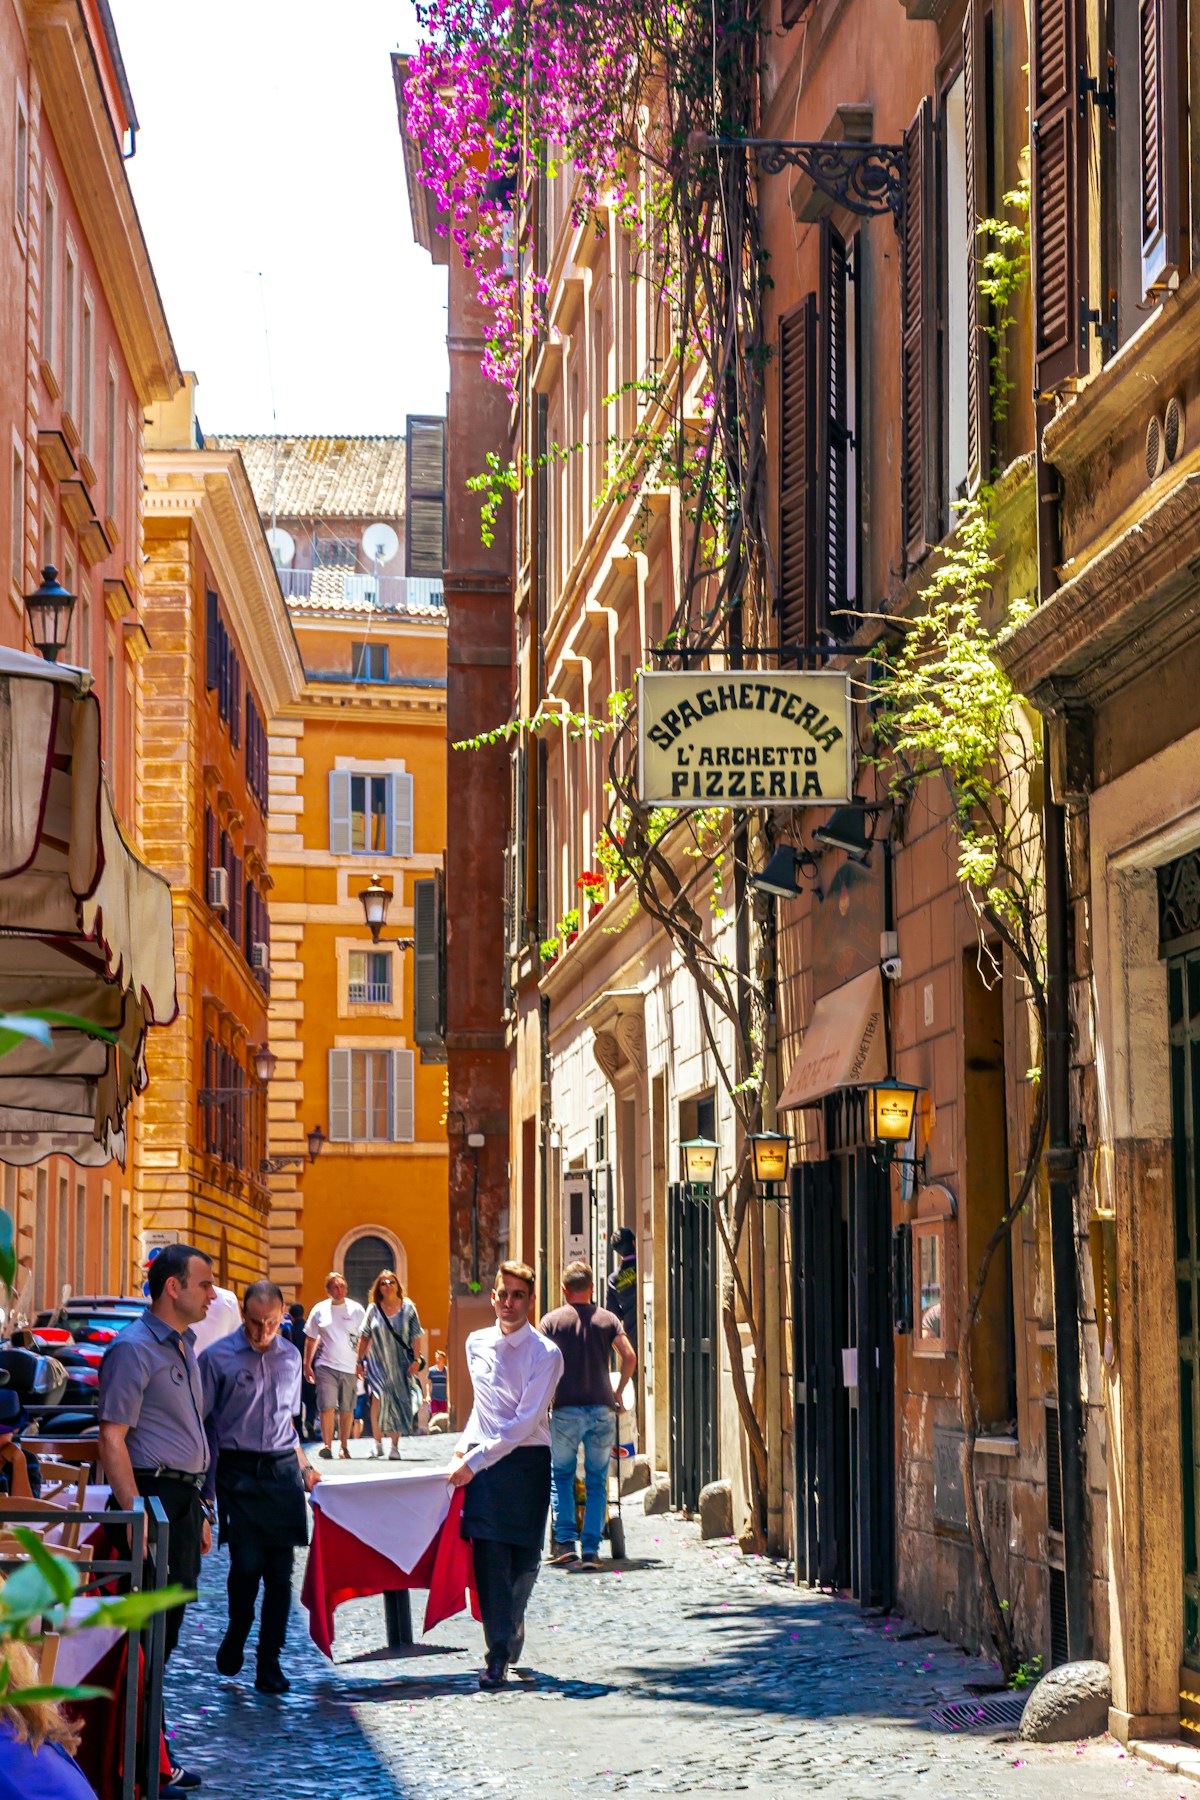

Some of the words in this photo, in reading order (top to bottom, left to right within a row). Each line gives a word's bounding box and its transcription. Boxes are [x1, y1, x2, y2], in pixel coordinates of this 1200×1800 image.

[646, 683, 844, 752] SPAGHETTERIA
[677, 744, 817, 766] L'ARCHETTO
[671, 771, 823, 797] PIZZERIA
[849, 1011, 881, 1080] SPAGHETTERIA
